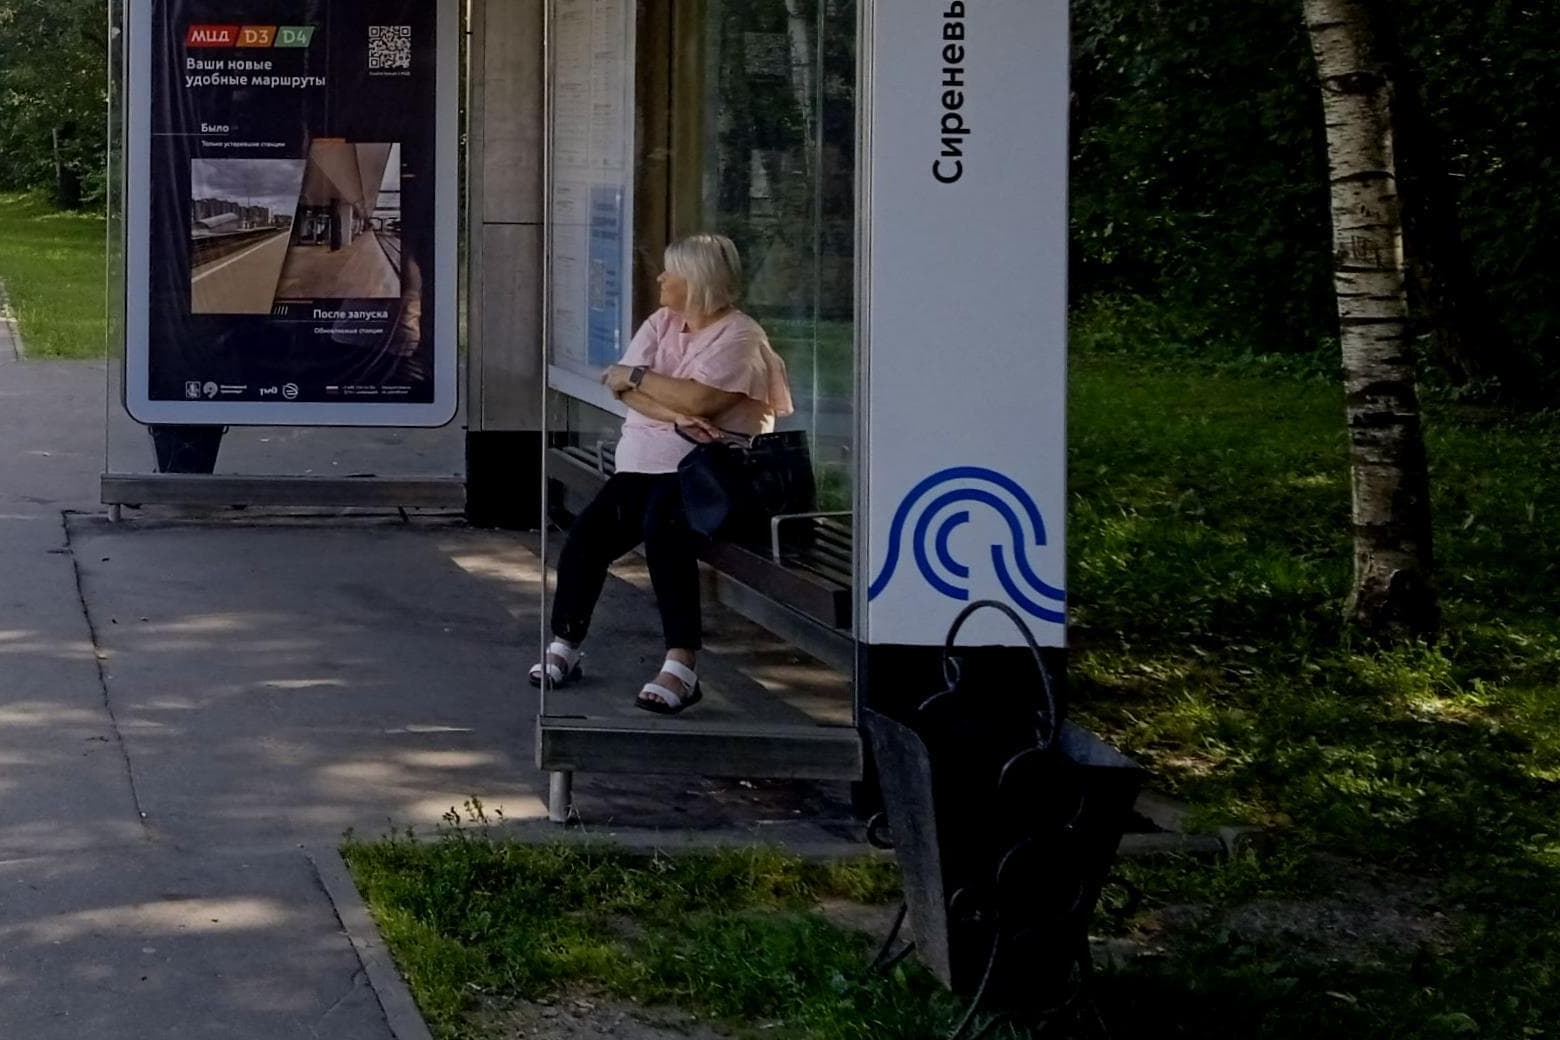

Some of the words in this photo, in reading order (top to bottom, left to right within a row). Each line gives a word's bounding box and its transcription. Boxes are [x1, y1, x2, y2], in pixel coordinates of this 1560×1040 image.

[191, 29, 230, 43] МЦД
[244, 30, 269, 44] D3
[282, 30, 308, 45] D4
[186, 58, 224, 70] Ваши
[228, 60, 272, 71] новые
[185, 73, 248, 87] удобные
[251, 75, 326, 88] маршруты
[201, 123, 230, 133] Было
[313, 309, 346, 319] После
[348, 311, 389, 321] запуска
